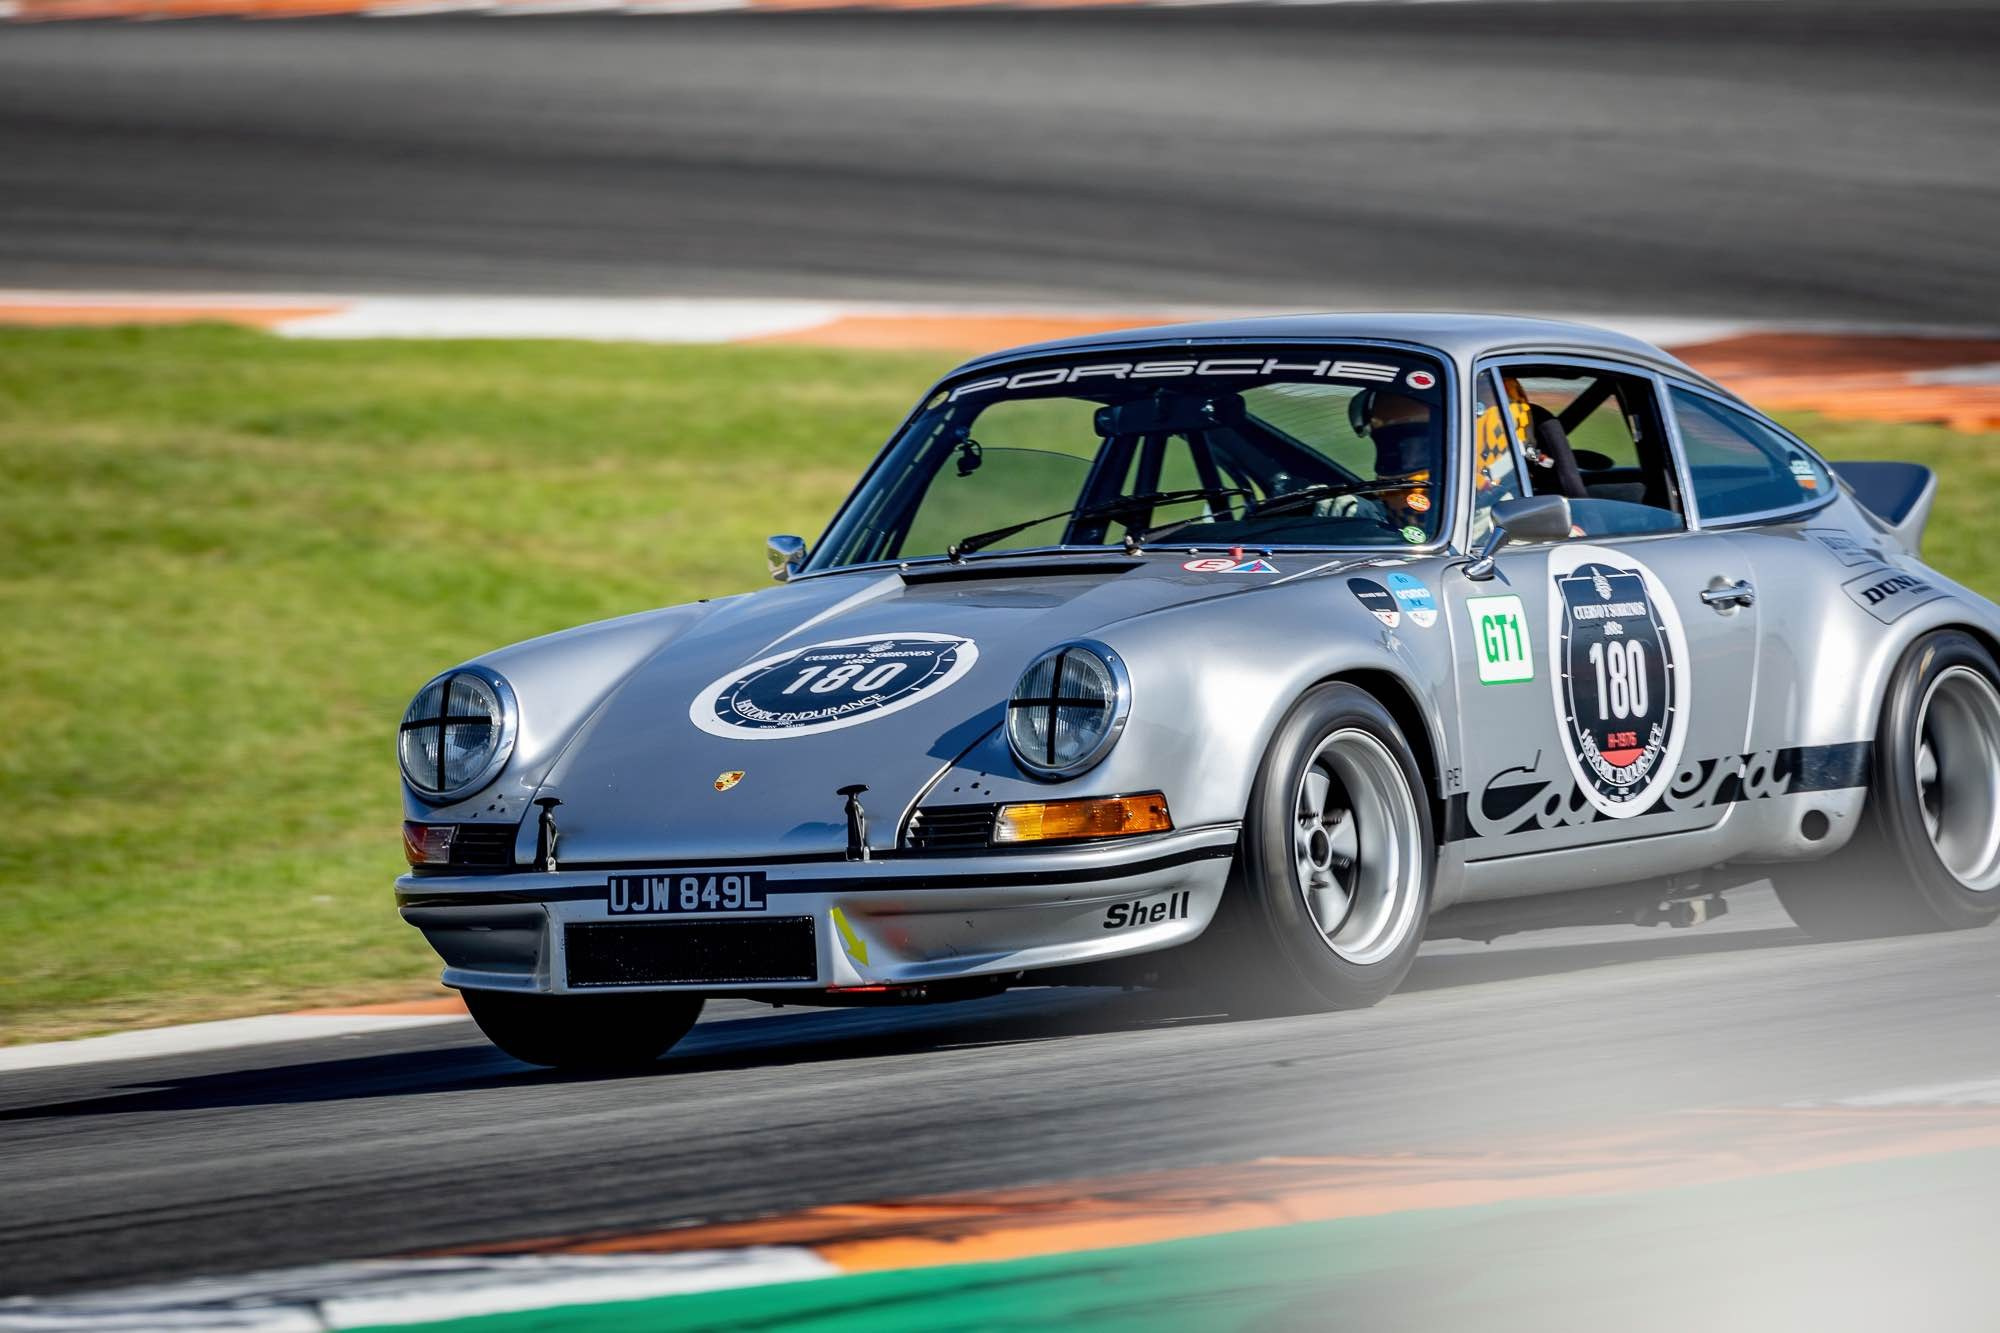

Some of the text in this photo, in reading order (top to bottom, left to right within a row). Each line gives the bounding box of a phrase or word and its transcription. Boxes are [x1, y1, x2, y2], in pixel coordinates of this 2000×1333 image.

[948, 358, 1400, 403] PORSCHE
[1861, 575, 1924, 606] DUNL
[1481, 614, 1524, 663] GT1
[782, 662, 908, 695] 180
[1589, 639, 1649, 720] 180
[736, 693, 886, 721] HISTORIC ENDURANCE
[1467, 749, 1793, 837] Caera
[610, 876, 764, 912] UJW 849L
[1103, 891, 1190, 929] Shell
